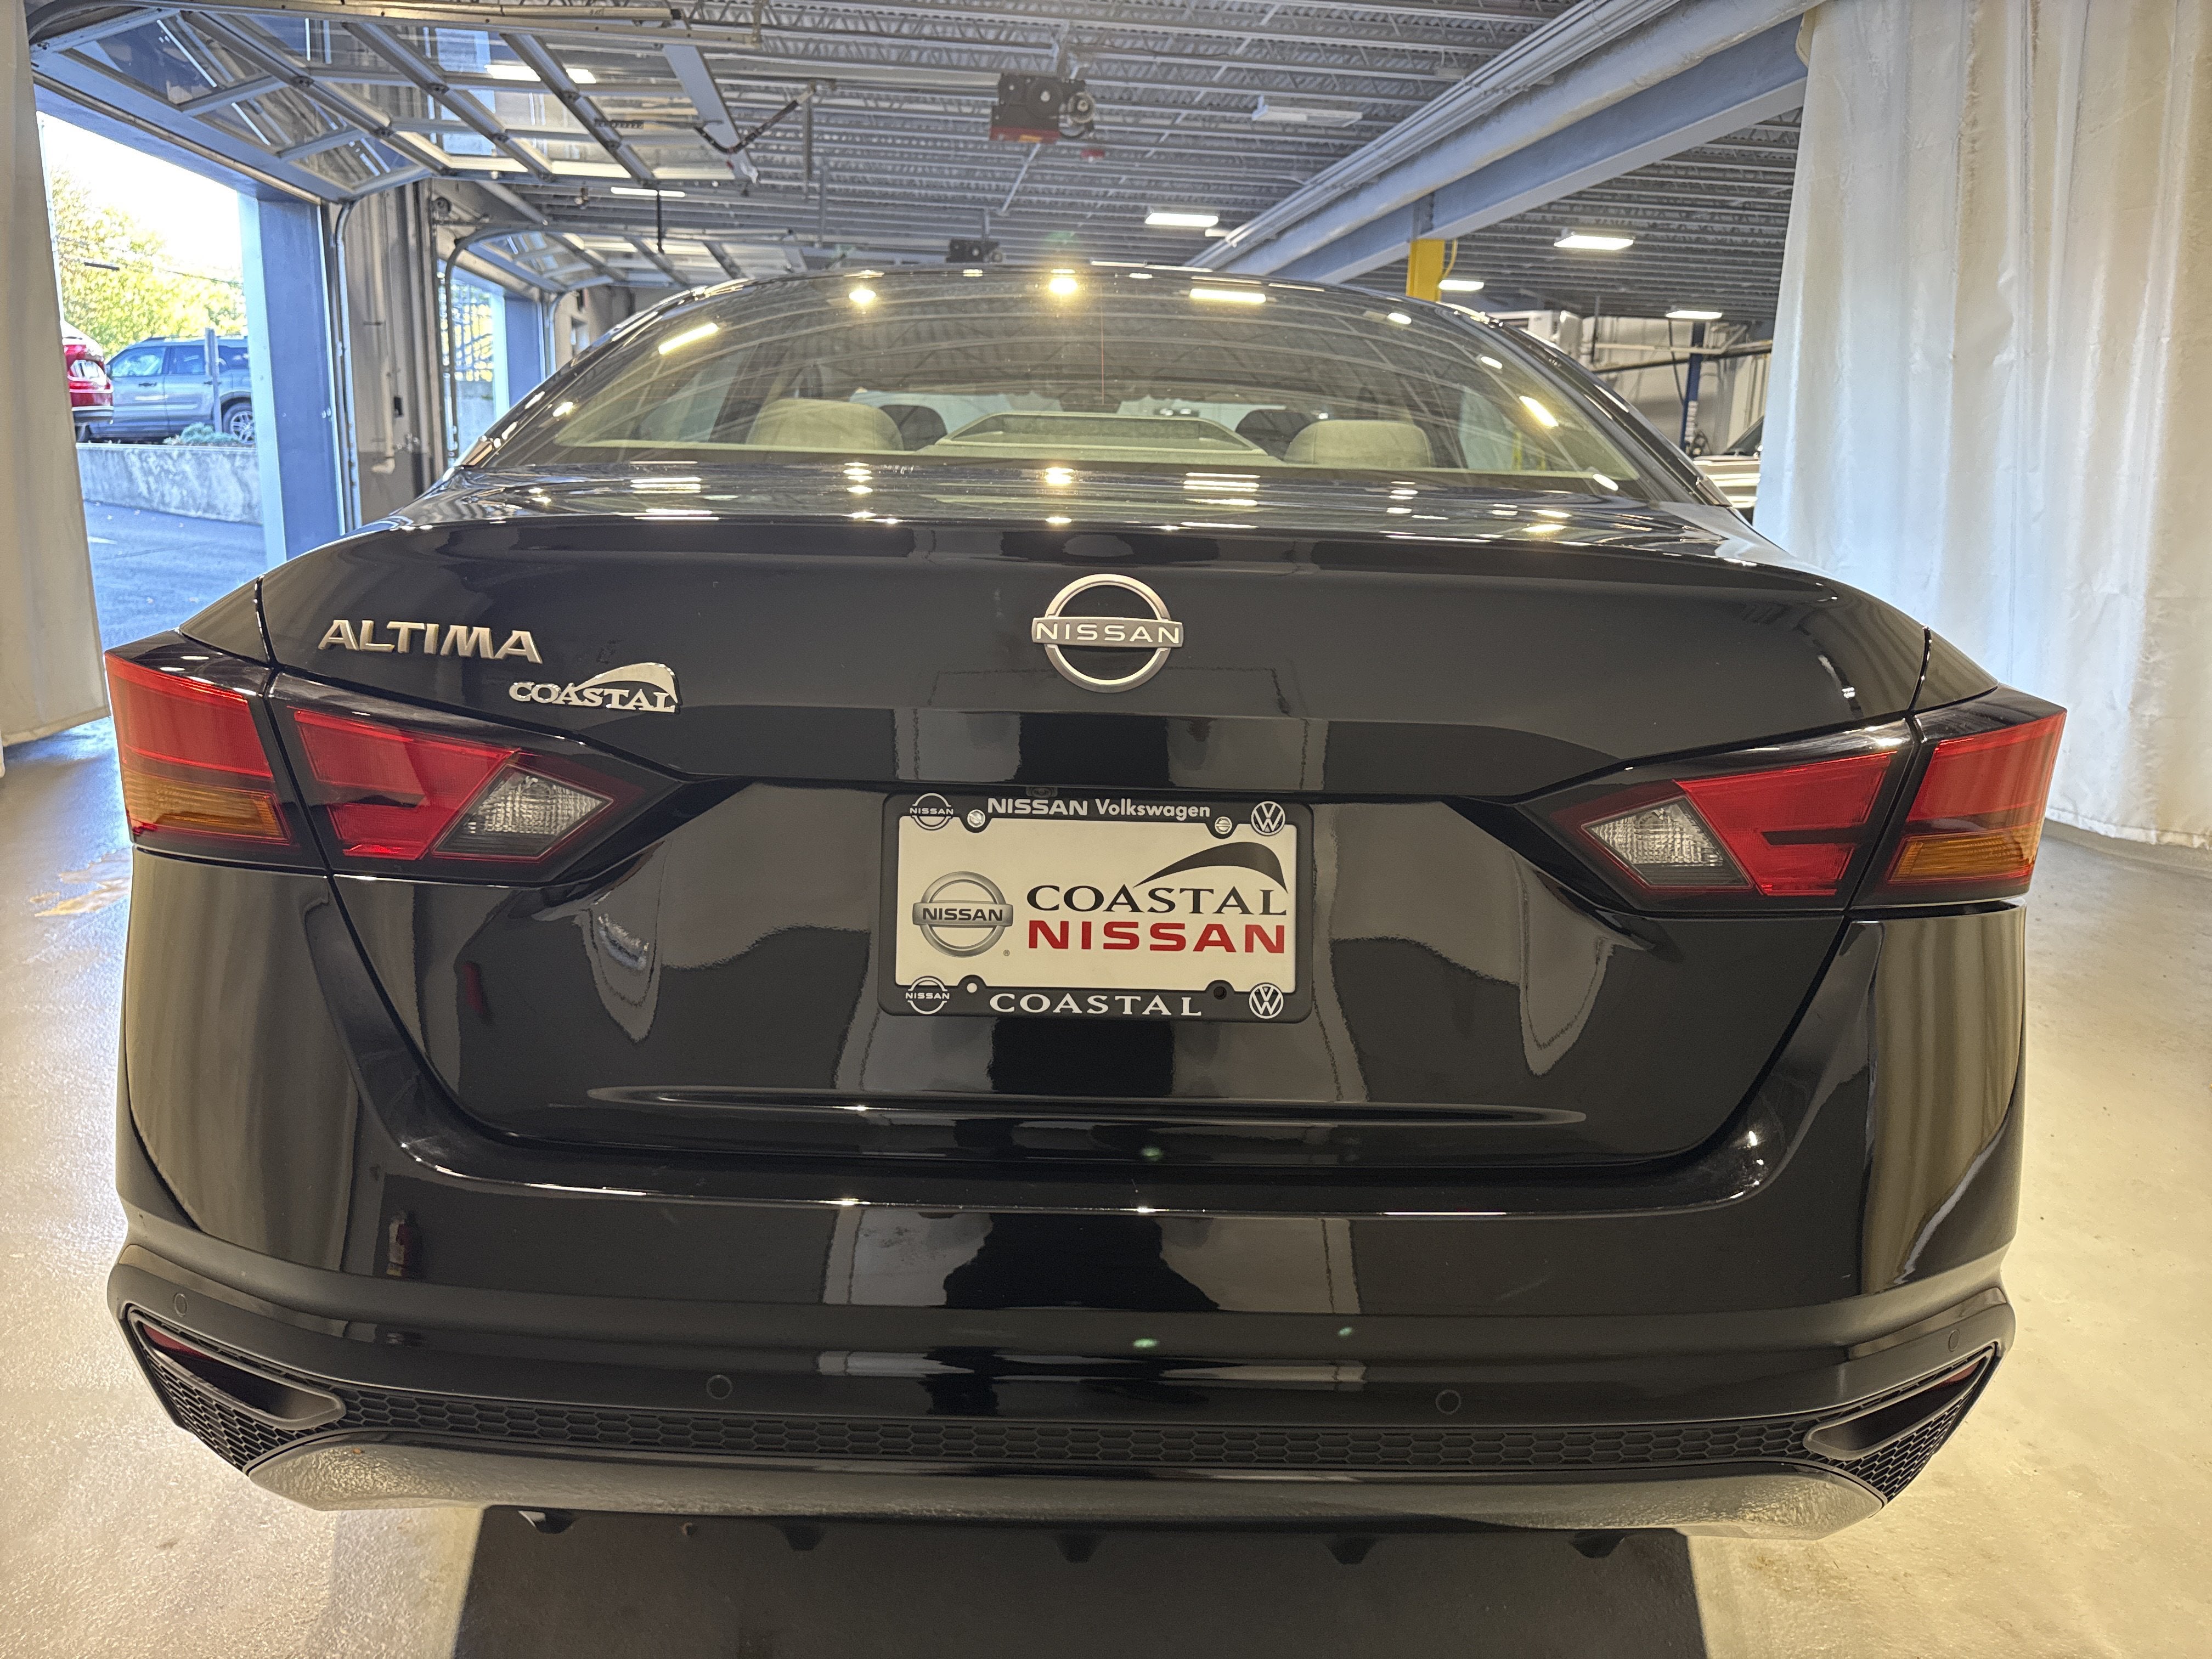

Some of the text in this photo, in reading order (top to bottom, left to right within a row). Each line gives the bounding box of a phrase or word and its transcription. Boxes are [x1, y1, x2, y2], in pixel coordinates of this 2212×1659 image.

[318, 619, 543, 664] ALTIMA
[1036, 622, 1180, 644] NISSAN
[509, 681, 677, 713] COASTAL
[910, 807, 954, 815] NISSAN
[988, 798, 1211, 821] NISSAN Volkswagen
[1026, 884, 1287, 917] COASTAL
[922, 906, 1003, 922] NISSAN
[1028, 919, 1285, 954] NISSAN
[989, 992, 1202, 1017] COASTAL
